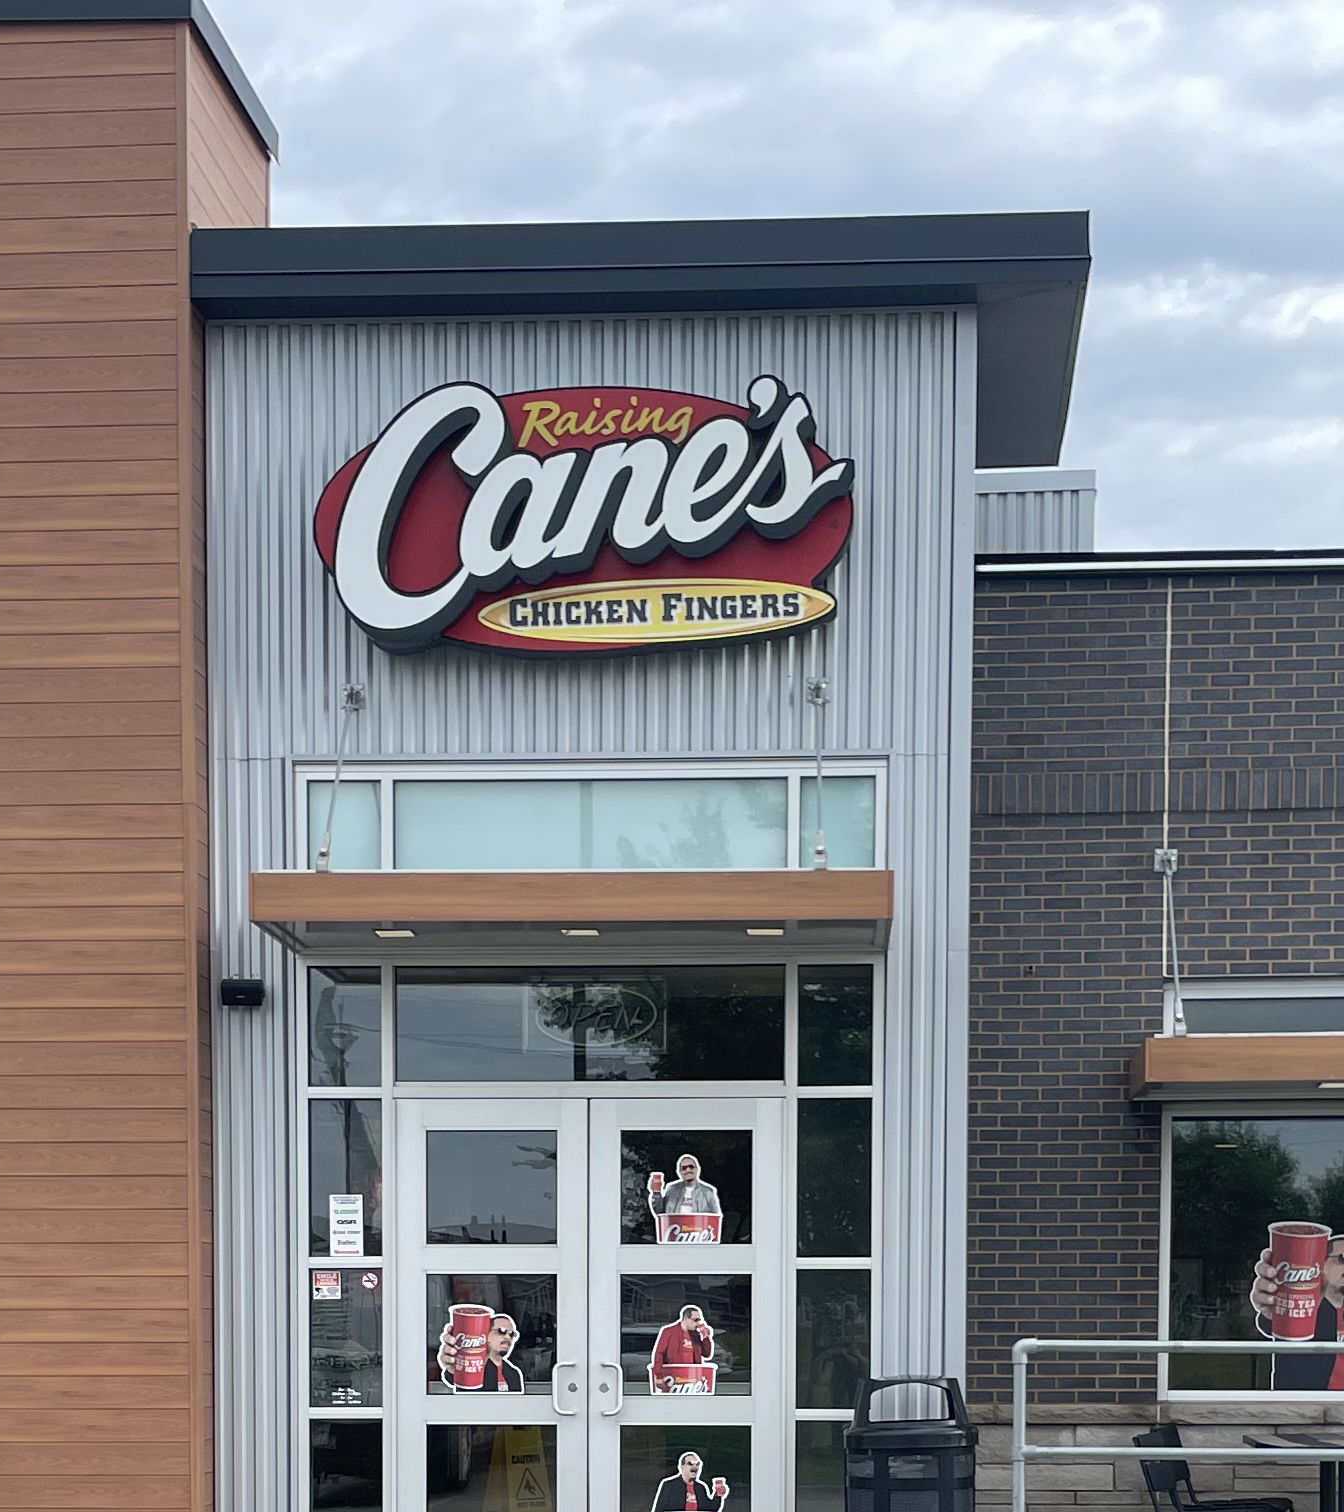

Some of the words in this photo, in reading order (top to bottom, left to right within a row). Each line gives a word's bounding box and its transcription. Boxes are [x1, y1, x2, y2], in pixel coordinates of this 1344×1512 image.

[518, 395, 695, 447] Raising
[334, 374, 855, 631] Cane's
[508, 596, 649, 627] CHICKEN
[660, 592, 802, 622] FINGERS
[551, 1000, 643, 1033] OPEN
[1274, 1261, 1322, 1285] Cane's
